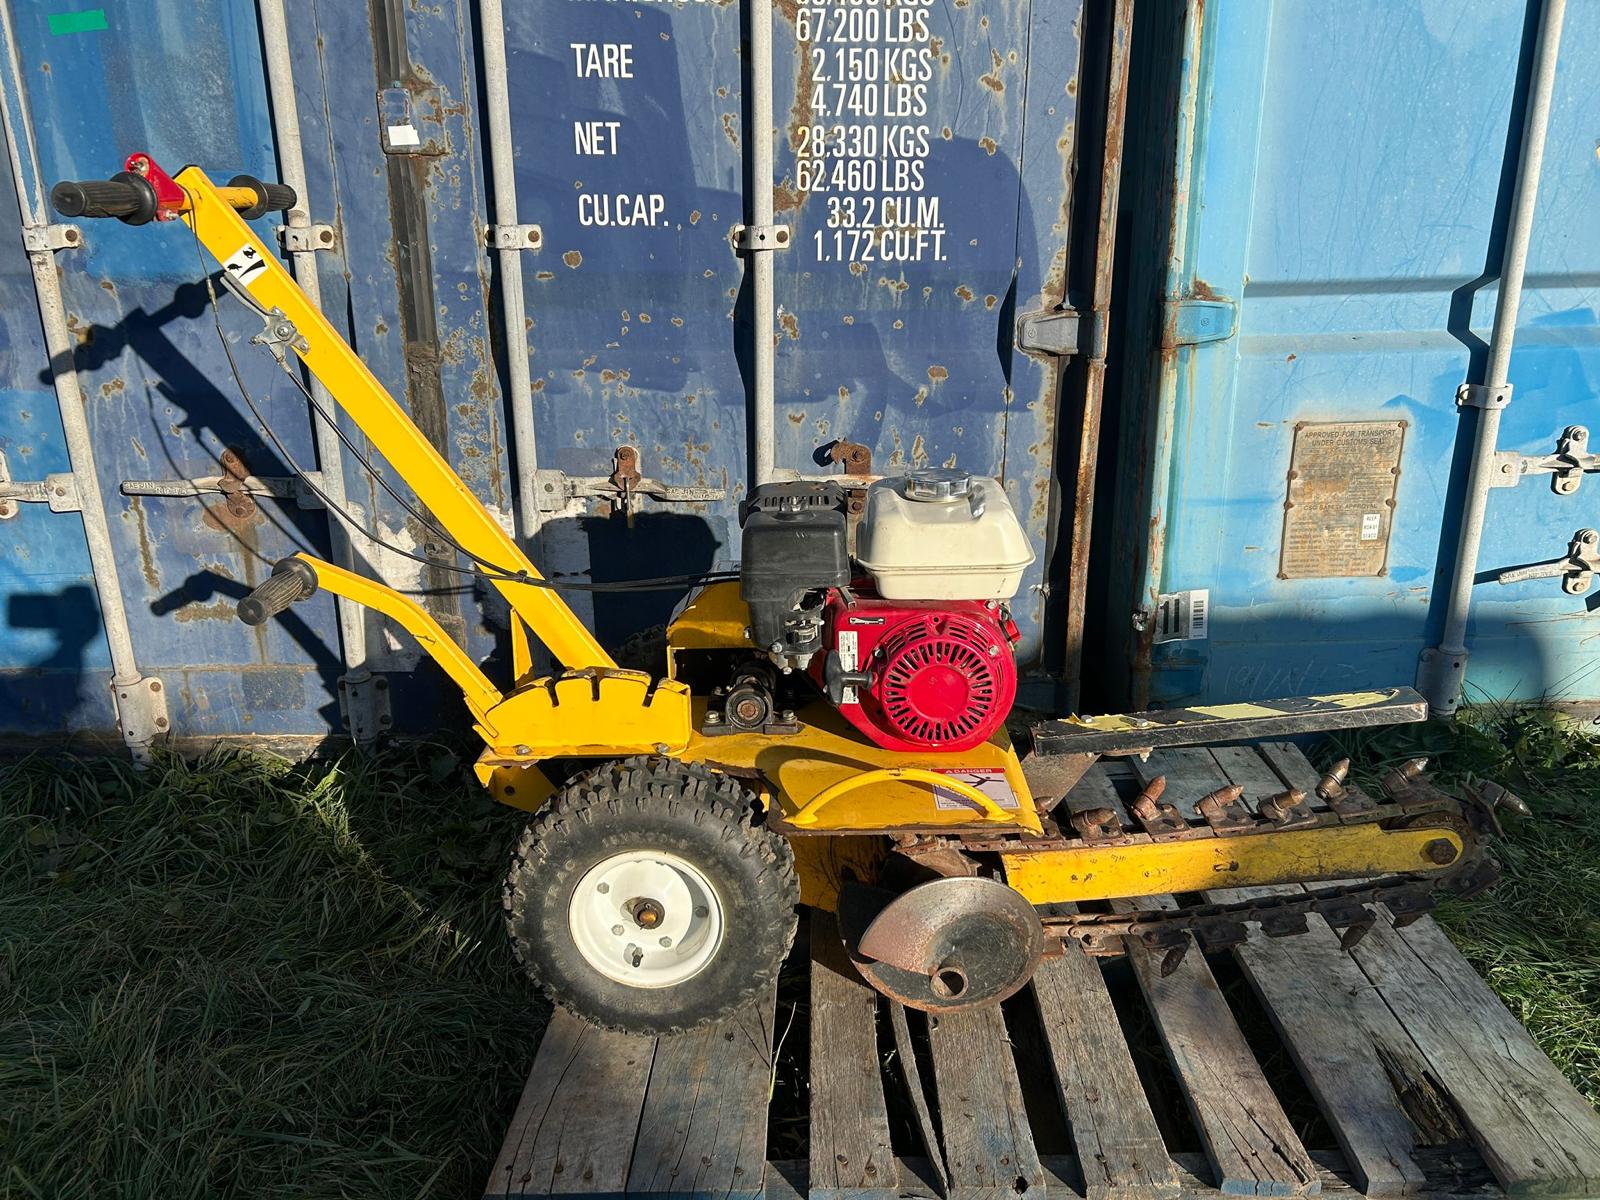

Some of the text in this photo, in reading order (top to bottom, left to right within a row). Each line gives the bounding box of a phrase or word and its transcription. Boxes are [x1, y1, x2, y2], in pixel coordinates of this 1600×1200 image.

[795, 7, 931, 43] 67,200 LBS
[570, 43, 634, 79] TARE
[811, 47, 933, 82] 2,150 KGS
[810, 82, 928, 118] 4,740 LBS
[574, 121, 621, 155] NET
[796, 124, 930, 159] 28,330 KGS
[795, 158, 925, 192] 62,460 LBS
[578, 193, 669, 227] CU.CAP.
[826, 196, 945, 230] 33.2 CU.M.
[814, 229, 947, 262] 1,172 CU.FT.
[1304, 431, 1341, 439] APPROVED
[1357, 429, 1396, 438] TRANSPORT
[1312, 439, 1334, 447] UNDER
[1336, 438, 1368, 446] CUSTOMS
